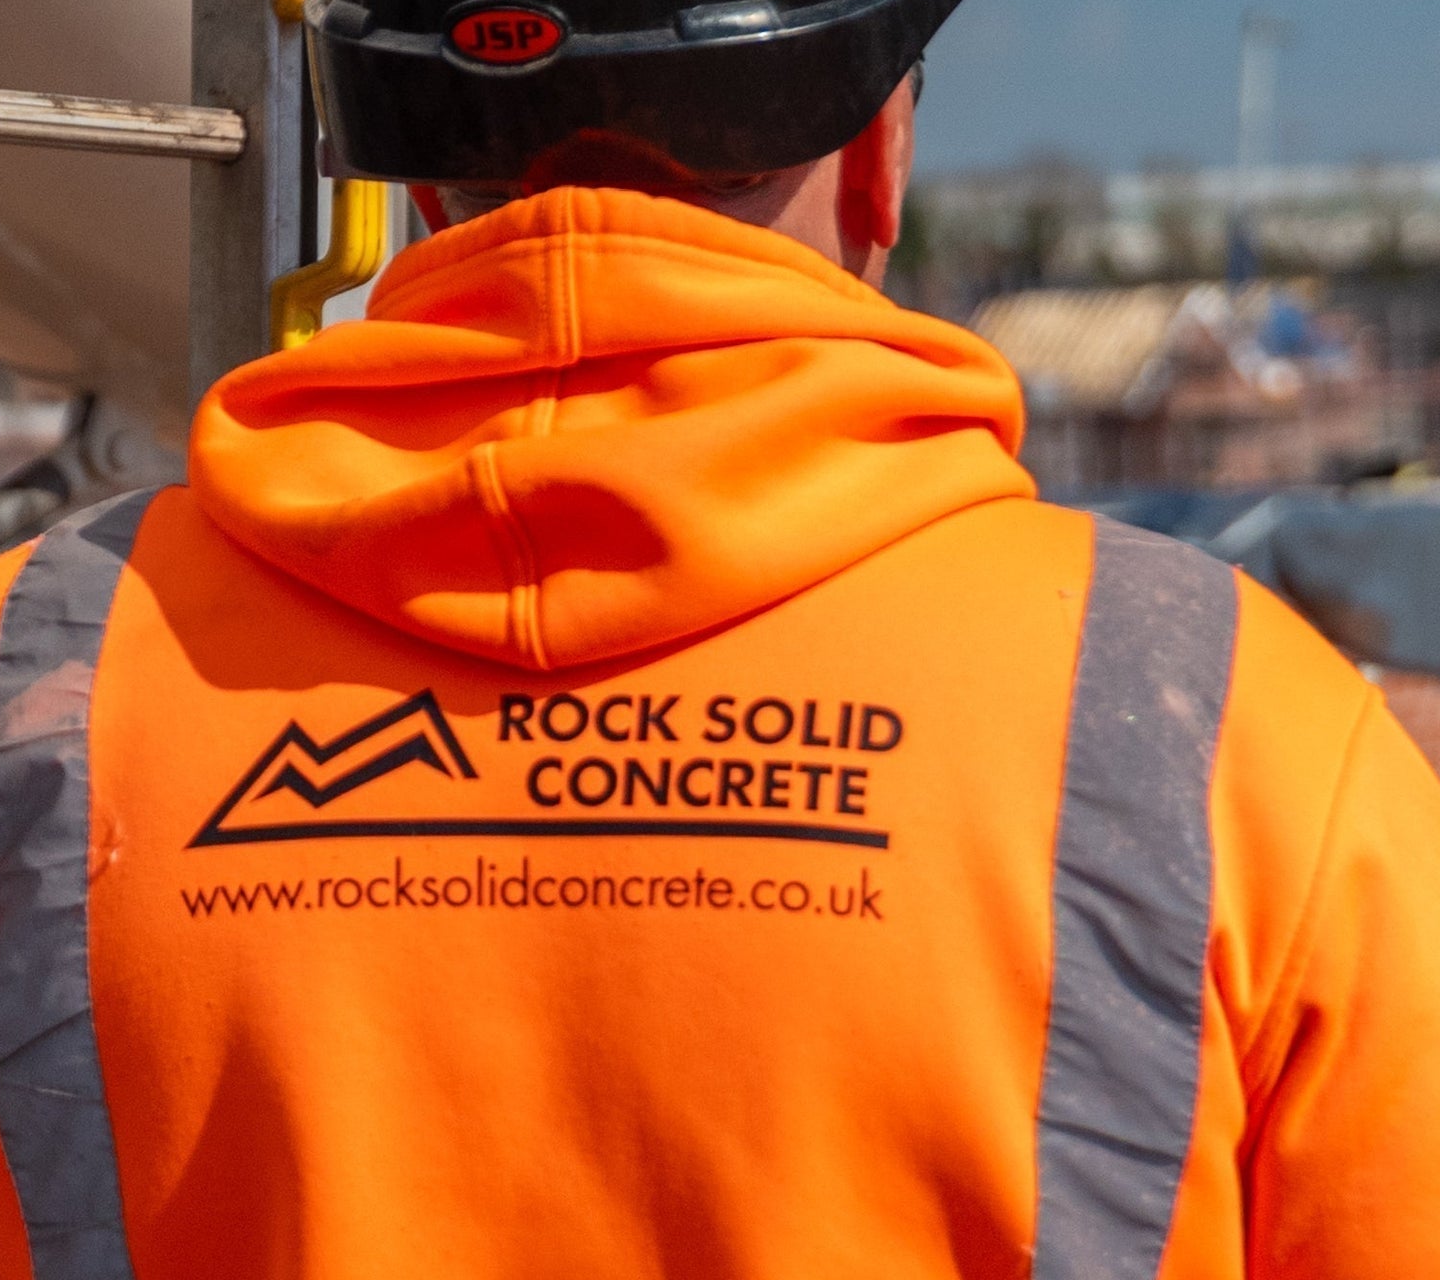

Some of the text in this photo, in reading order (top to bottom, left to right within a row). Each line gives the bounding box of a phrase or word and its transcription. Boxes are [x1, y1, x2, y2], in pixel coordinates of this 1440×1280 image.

[466, 20, 544, 51] JSP
[497, 692, 903, 753] ROCK SOLID
[527, 756, 869, 815] CONCRETE
[181, 856, 883, 921] www.rocksolidconcrete.co.uk
